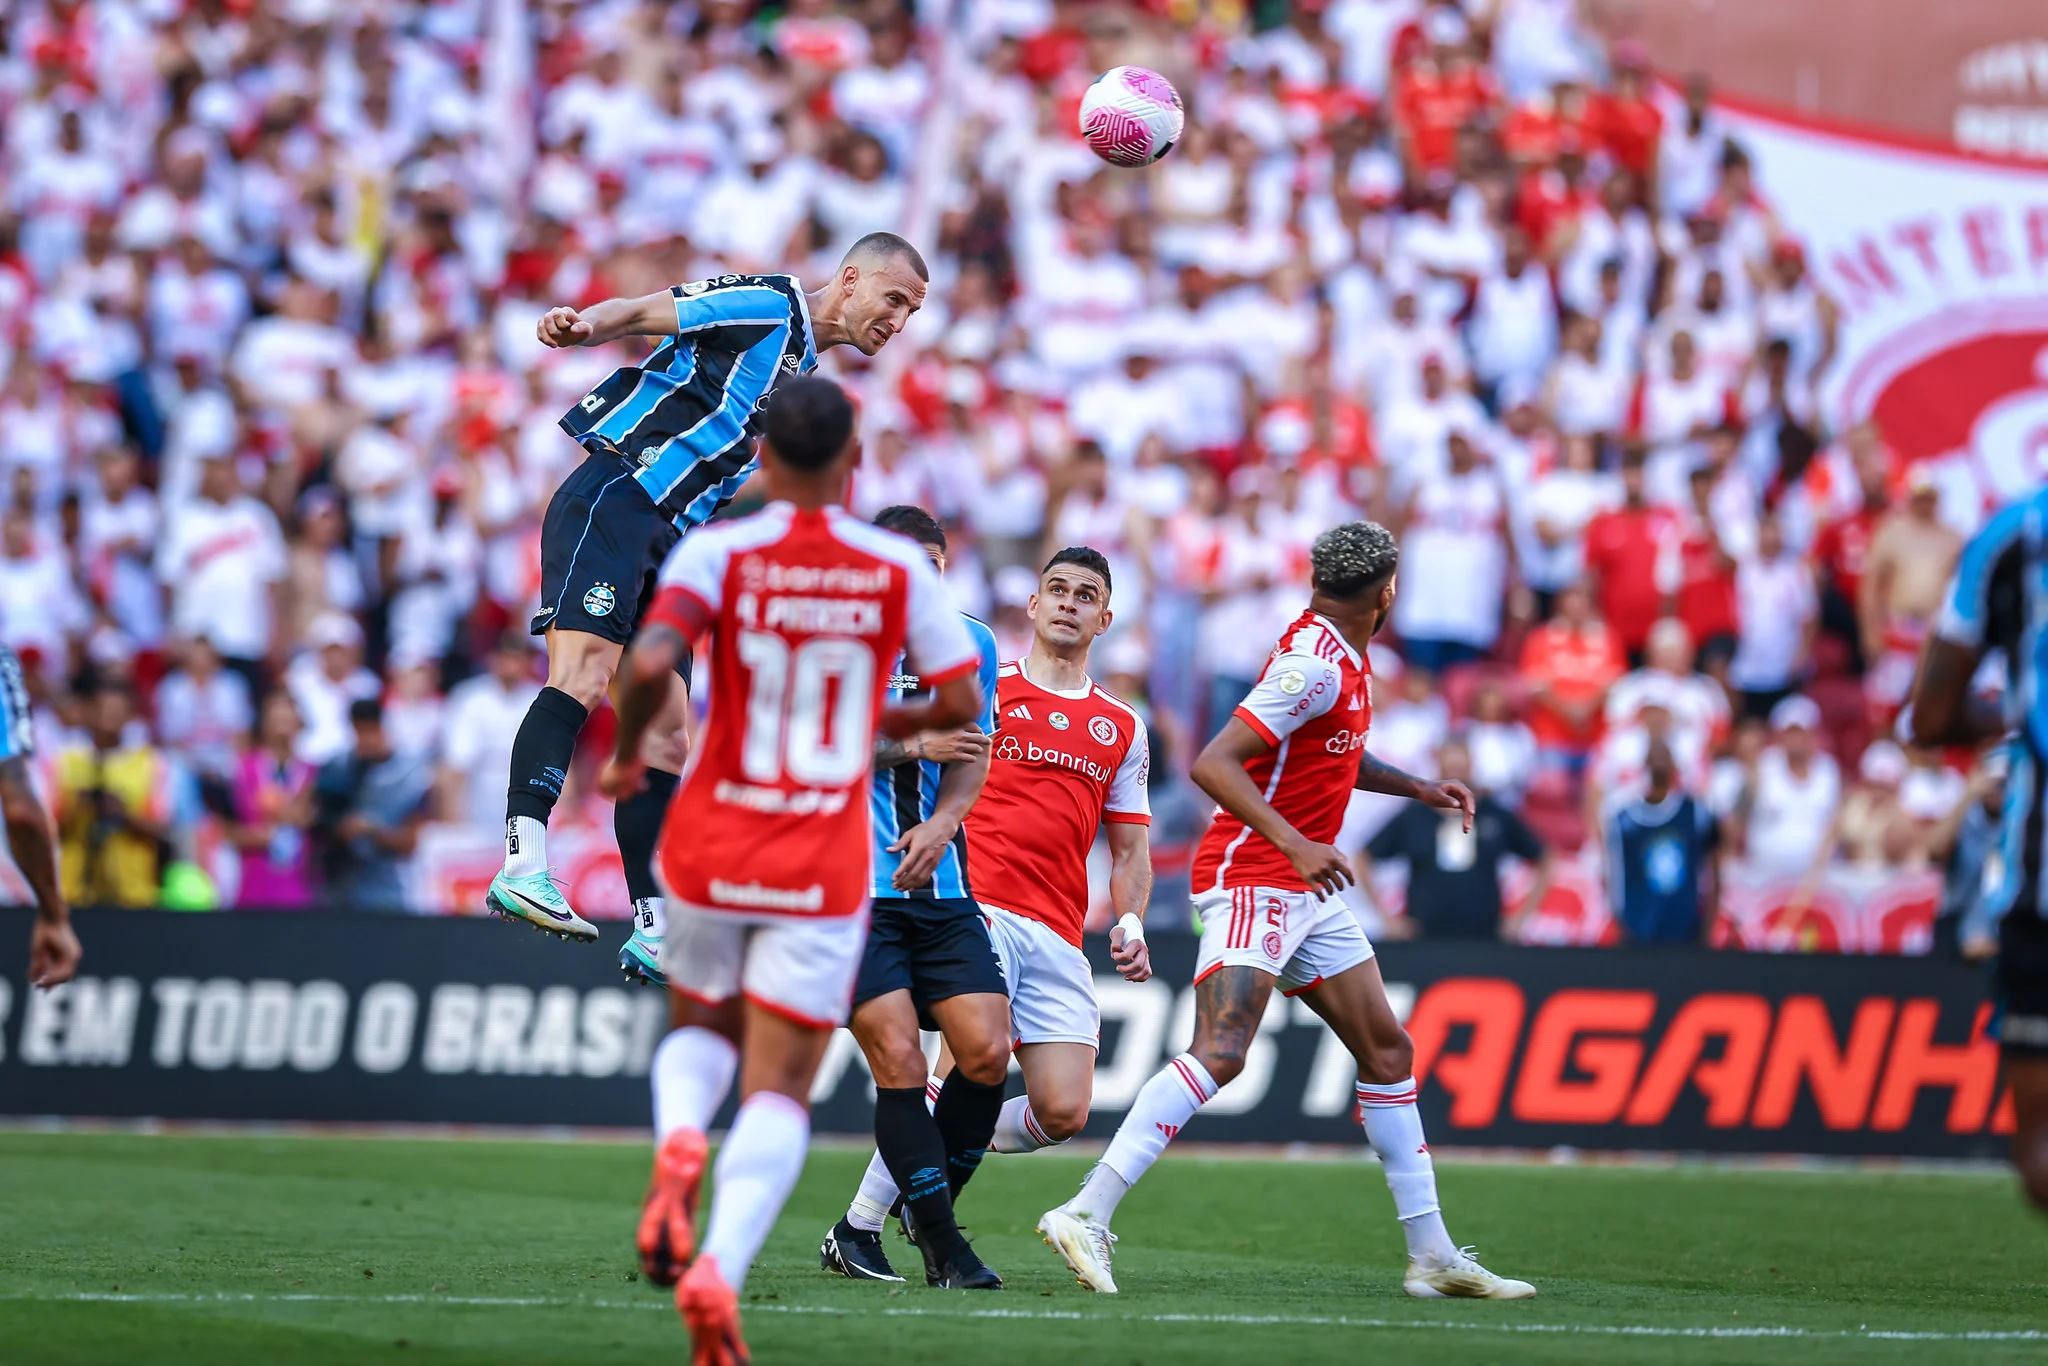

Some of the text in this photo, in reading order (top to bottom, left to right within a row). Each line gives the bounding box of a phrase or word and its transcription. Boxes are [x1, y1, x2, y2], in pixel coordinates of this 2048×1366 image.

[736, 629, 878, 787] 10
[1027, 741, 1112, 784] banrisul
[1267, 897, 1289, 933] 21
[19, 976, 141, 1068] EM
[151, 977, 348, 1072] TODO
[353, 981, 418, 1074] O
[421, 983, 664, 1078] BRASI
